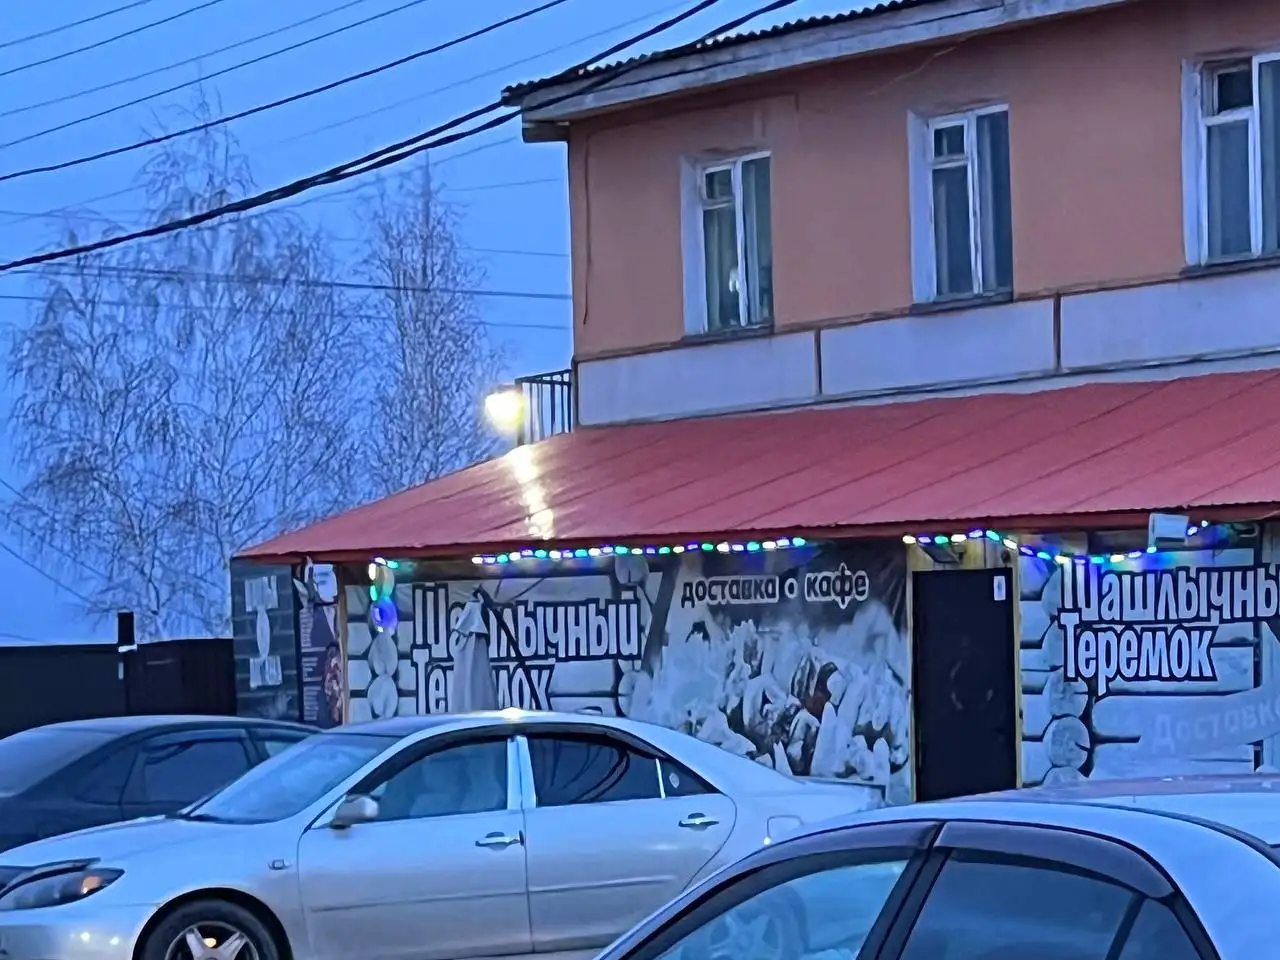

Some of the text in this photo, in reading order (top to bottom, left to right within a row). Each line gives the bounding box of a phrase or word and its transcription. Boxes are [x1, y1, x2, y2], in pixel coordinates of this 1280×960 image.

[681, 577, 779, 609] доставка
[804, 562, 869, 609] кафе
[1059, 611, 1214, 696] Теремок
